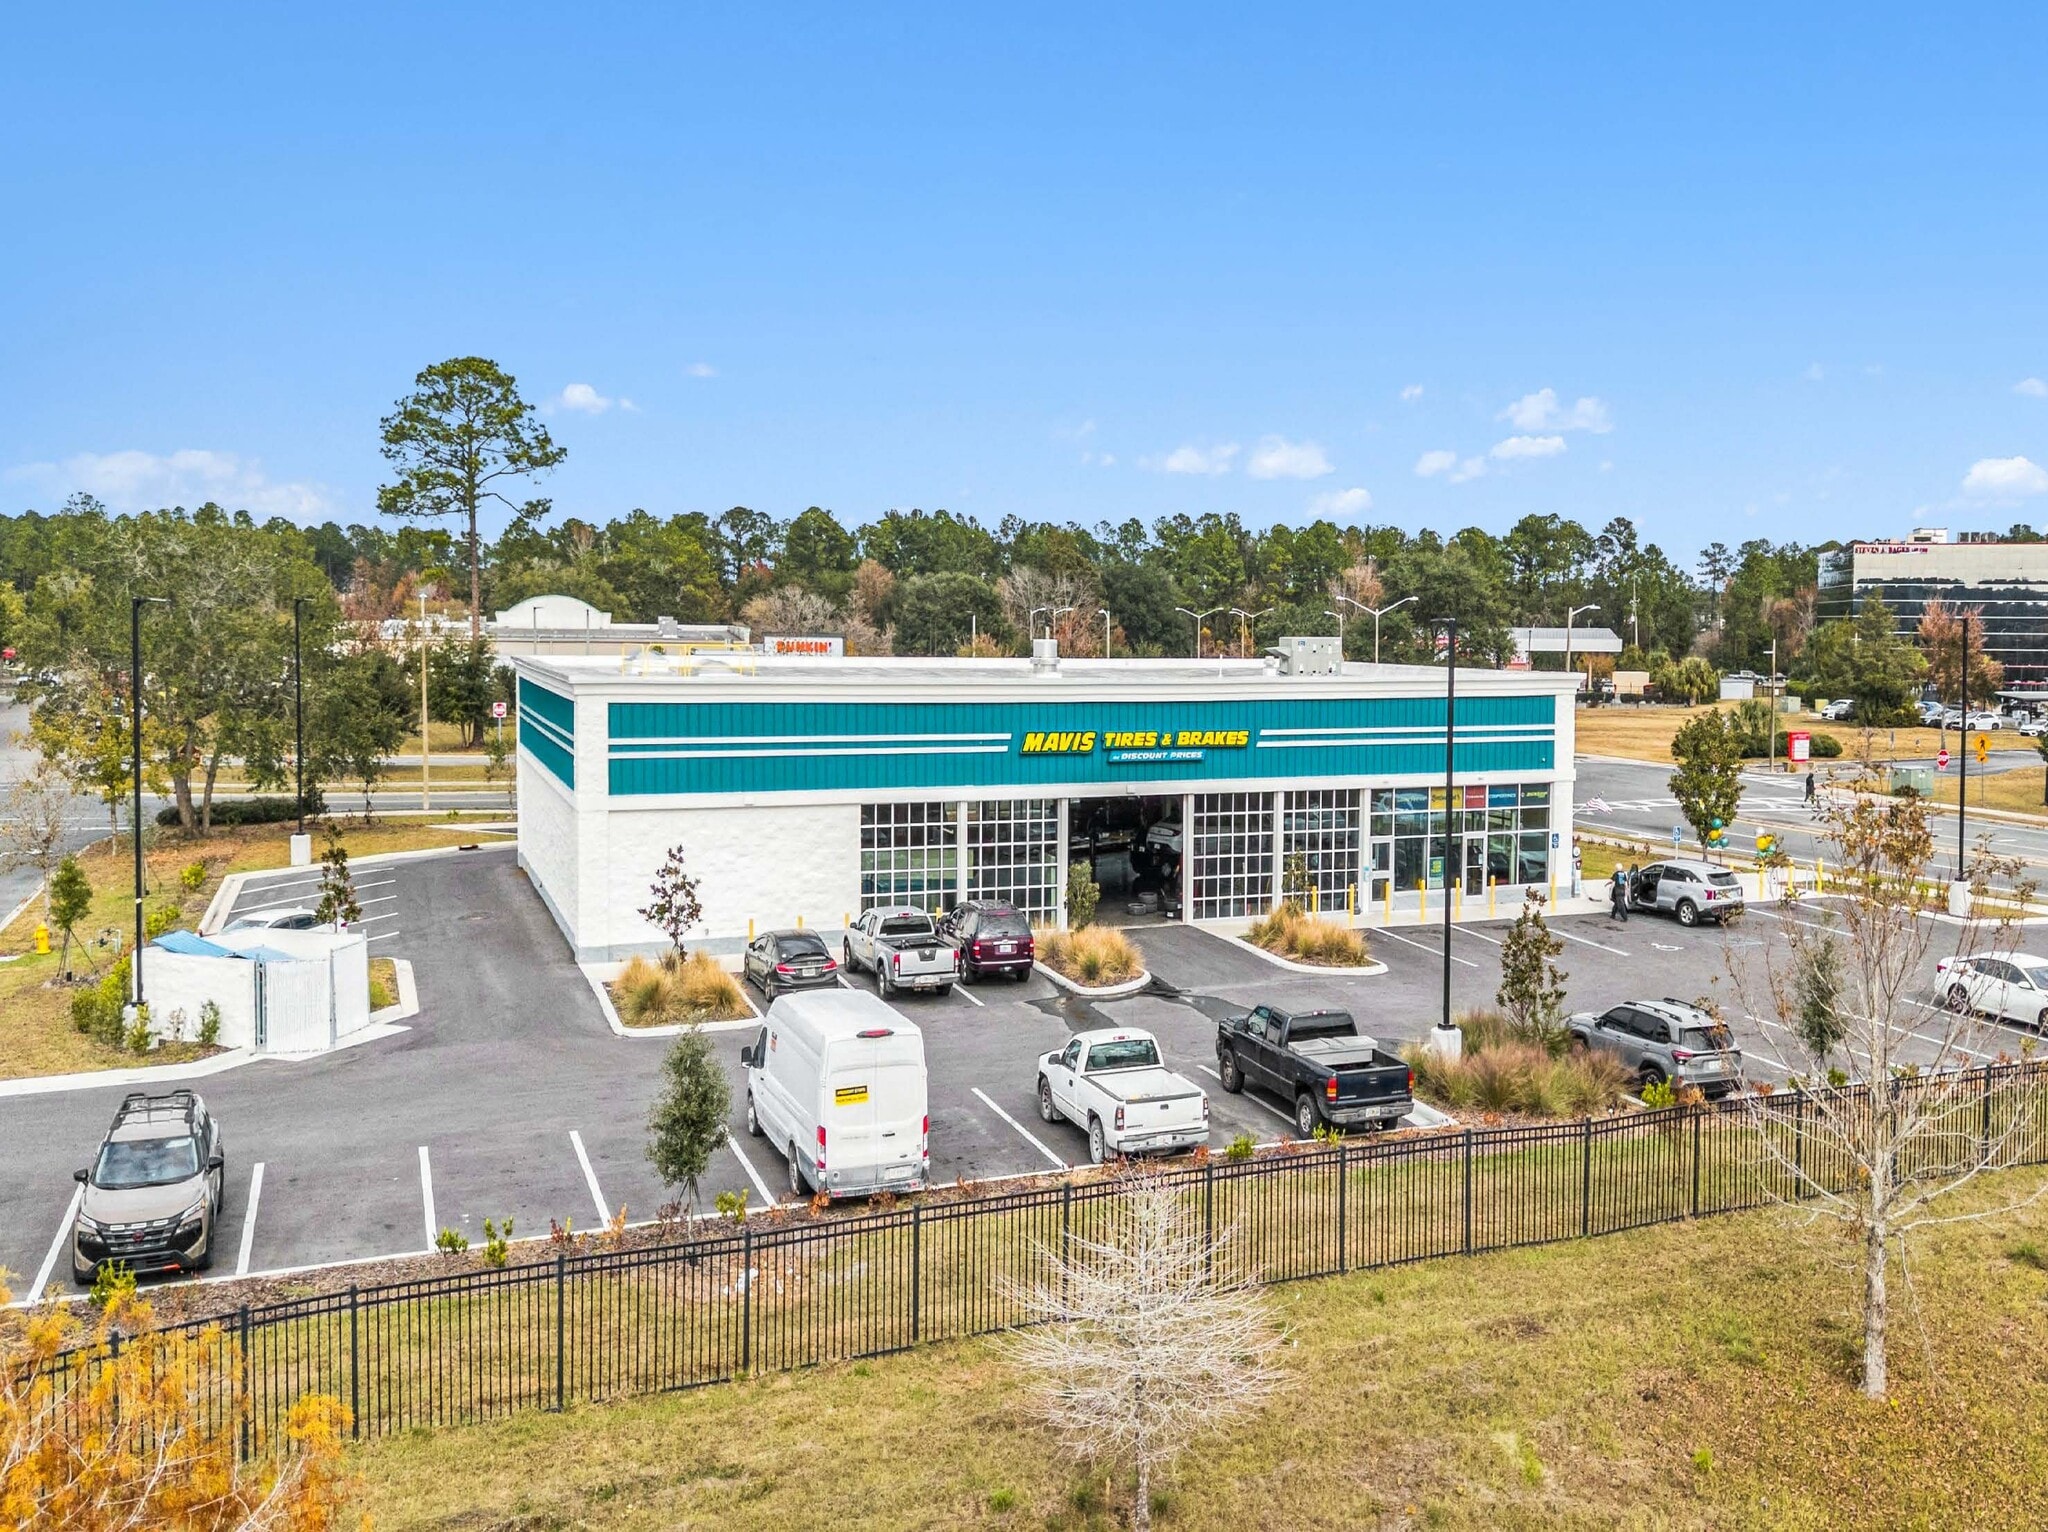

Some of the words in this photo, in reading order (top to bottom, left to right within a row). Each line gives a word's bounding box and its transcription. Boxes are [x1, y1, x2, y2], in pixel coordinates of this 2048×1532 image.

[1022, 731, 1095, 752] MAVIS
[1104, 731, 1157, 747] TIRES
[1161, 733, 1171, 747] &
[1176, 730, 1250, 746] BRAKES
[1121, 752, 1168, 760] DISCOUNT
[1170, 751, 1203, 759] PRICES
